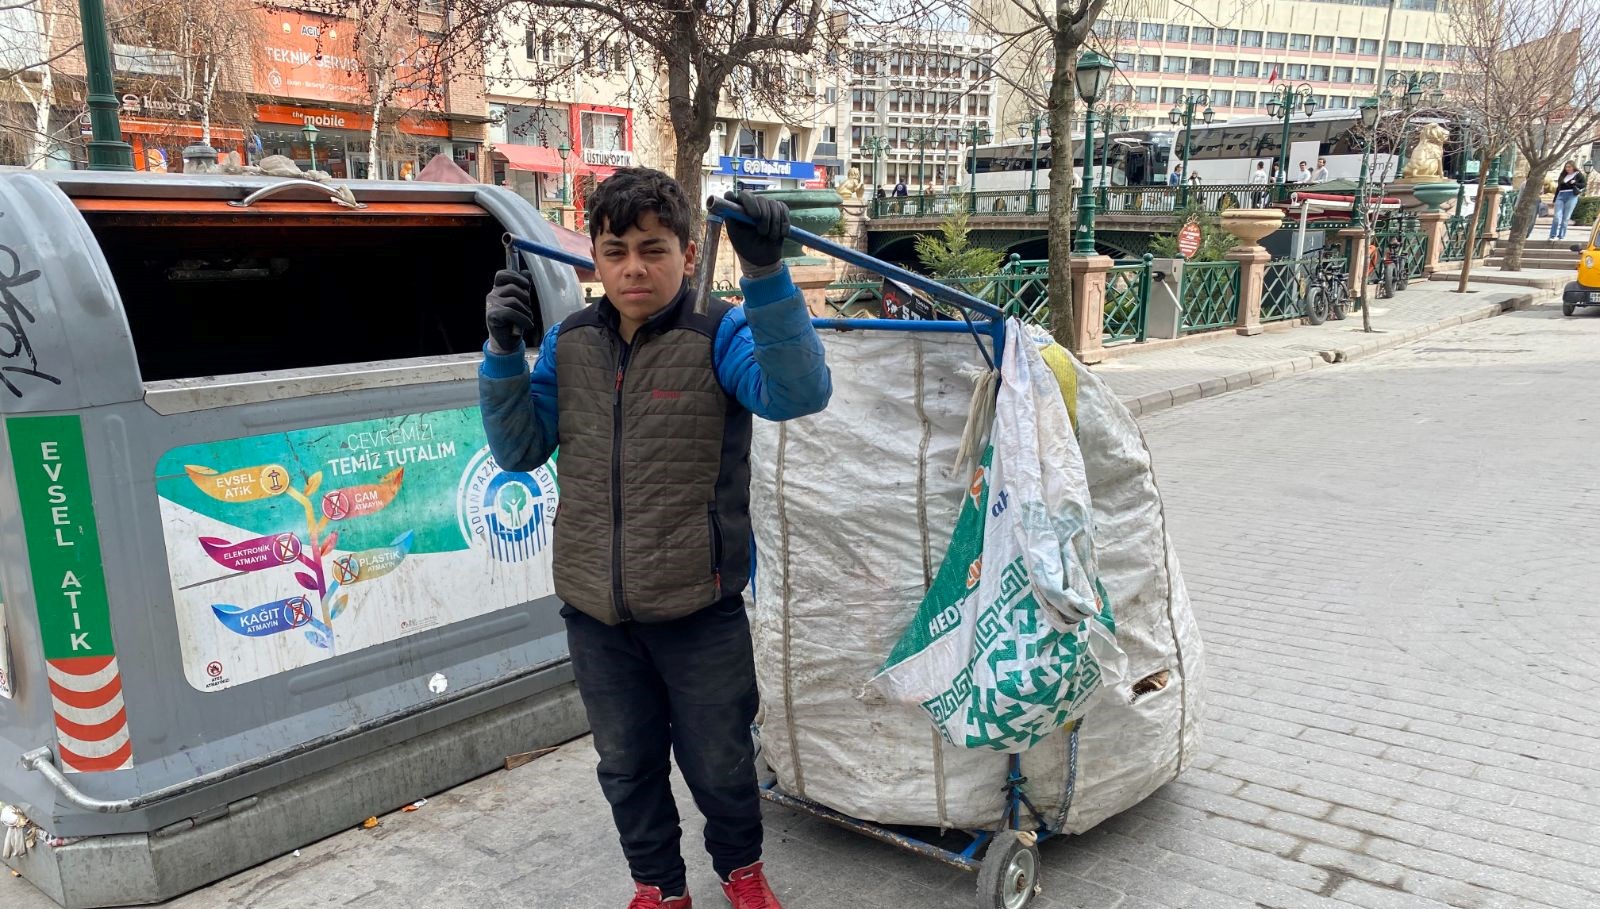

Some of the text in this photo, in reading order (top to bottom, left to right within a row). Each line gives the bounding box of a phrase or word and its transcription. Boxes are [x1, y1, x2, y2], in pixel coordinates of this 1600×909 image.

[265, 47, 313, 66] TEKNİK
[292, 111, 345, 127] the mobile
[328, 440, 456, 476] TEMİZ TUTALIM
[216, 473, 256, 488] EVSEL
[354, 490, 378, 502] CAM
[354, 500, 383, 511] ATMAYIN
[41, 441, 92, 650] EVSEL ATIK
[235, 554, 267, 566] ATMAYIN
[367, 561, 395, 572] ATMAYIN
[240, 607, 280, 627] KAĞIT
[246, 620, 279, 633] ATMAYIN
